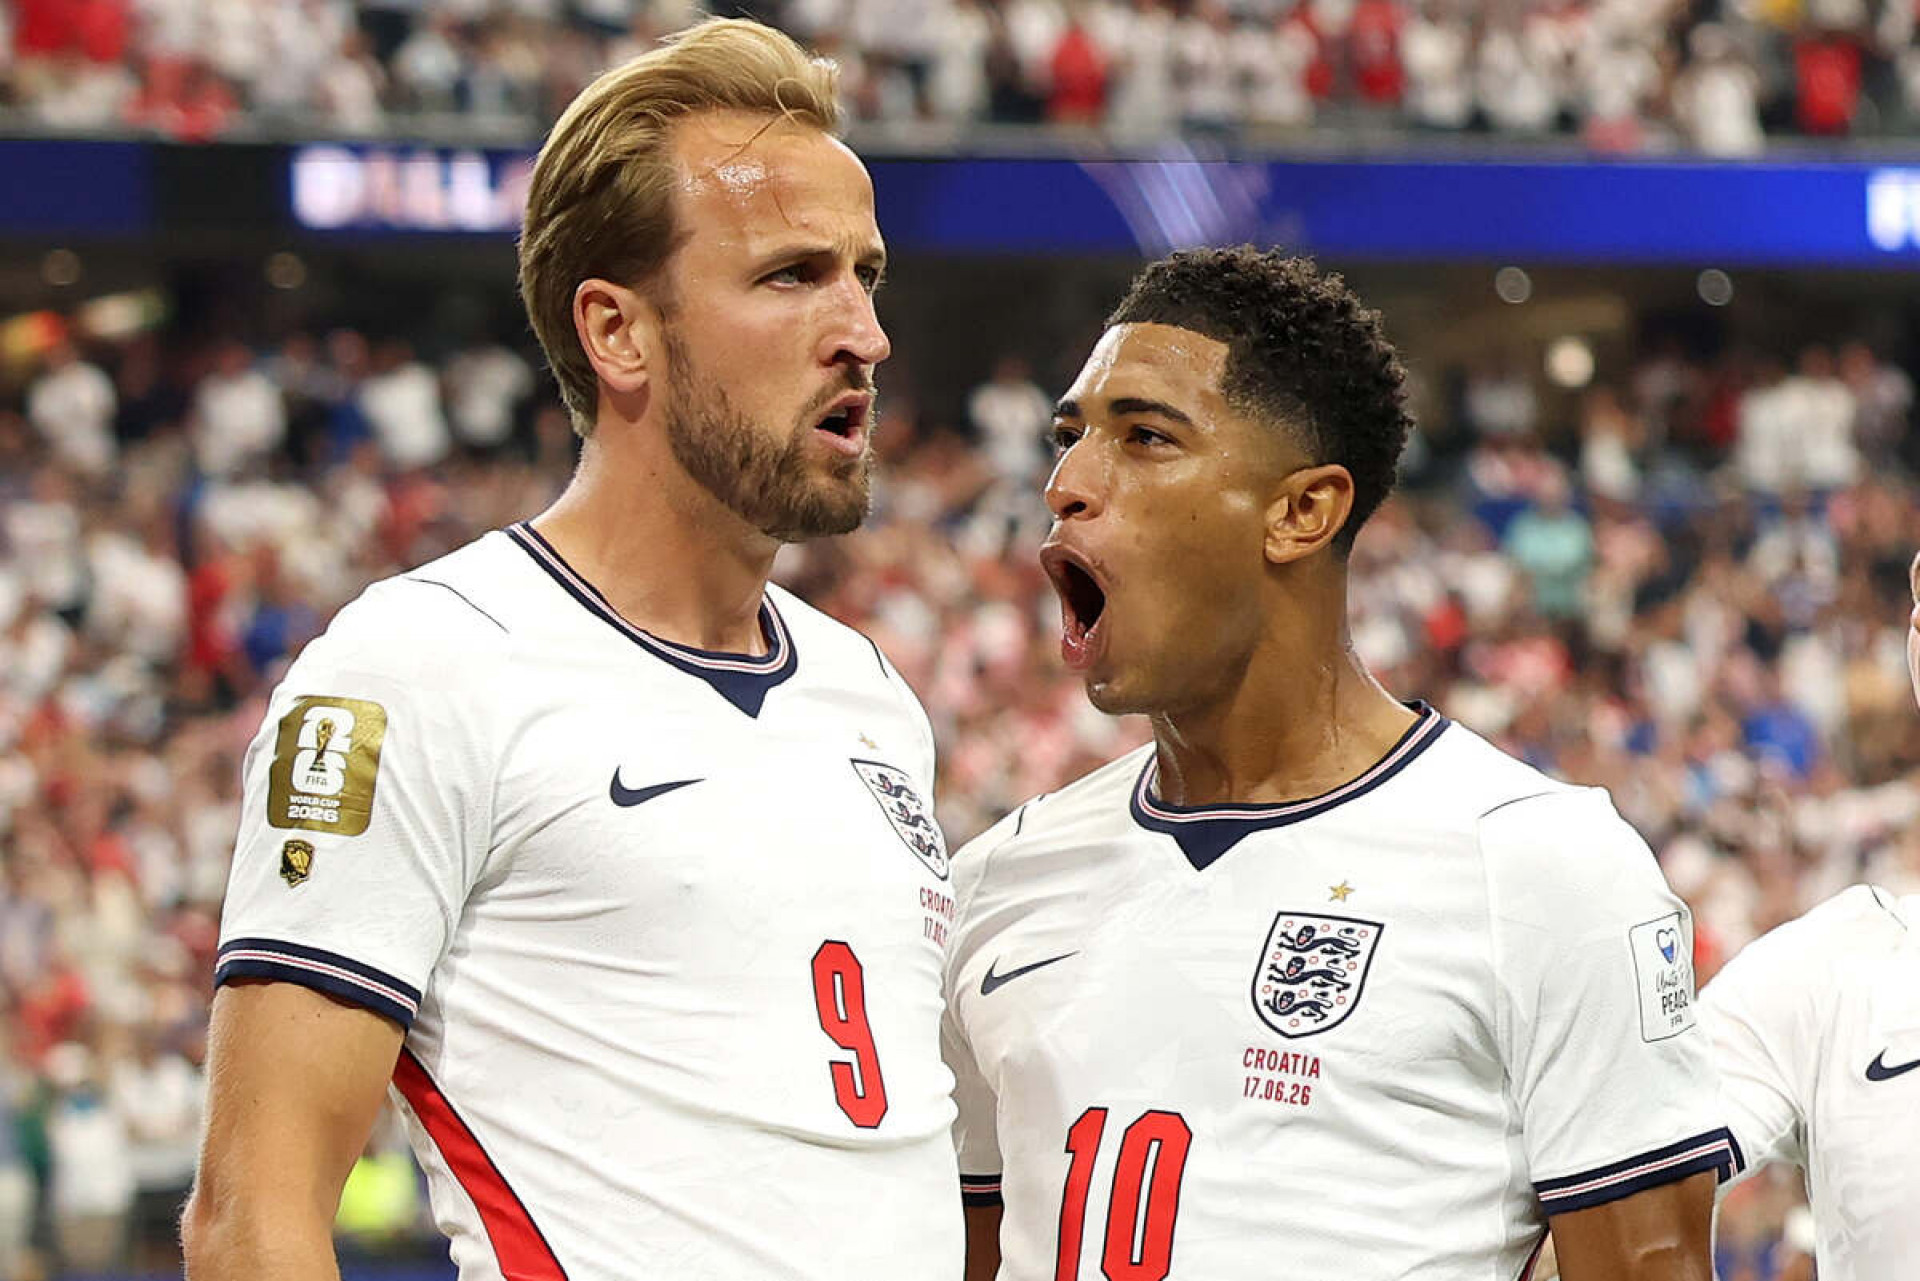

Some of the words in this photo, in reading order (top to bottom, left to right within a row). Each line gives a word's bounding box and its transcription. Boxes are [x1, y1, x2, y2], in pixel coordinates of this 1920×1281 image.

[305, 775, 328, 787] FIFA
[287, 805, 339, 823] 2026
[289, 795, 320, 806] WORLD
[320, 798, 341, 808] CUP
[811, 939, 888, 1129] 9
[1242, 1047, 1321, 1079] CROATIA
[1243, 1076, 1312, 1107] 17.06.26
[1054, 1107, 1193, 1281] 10
